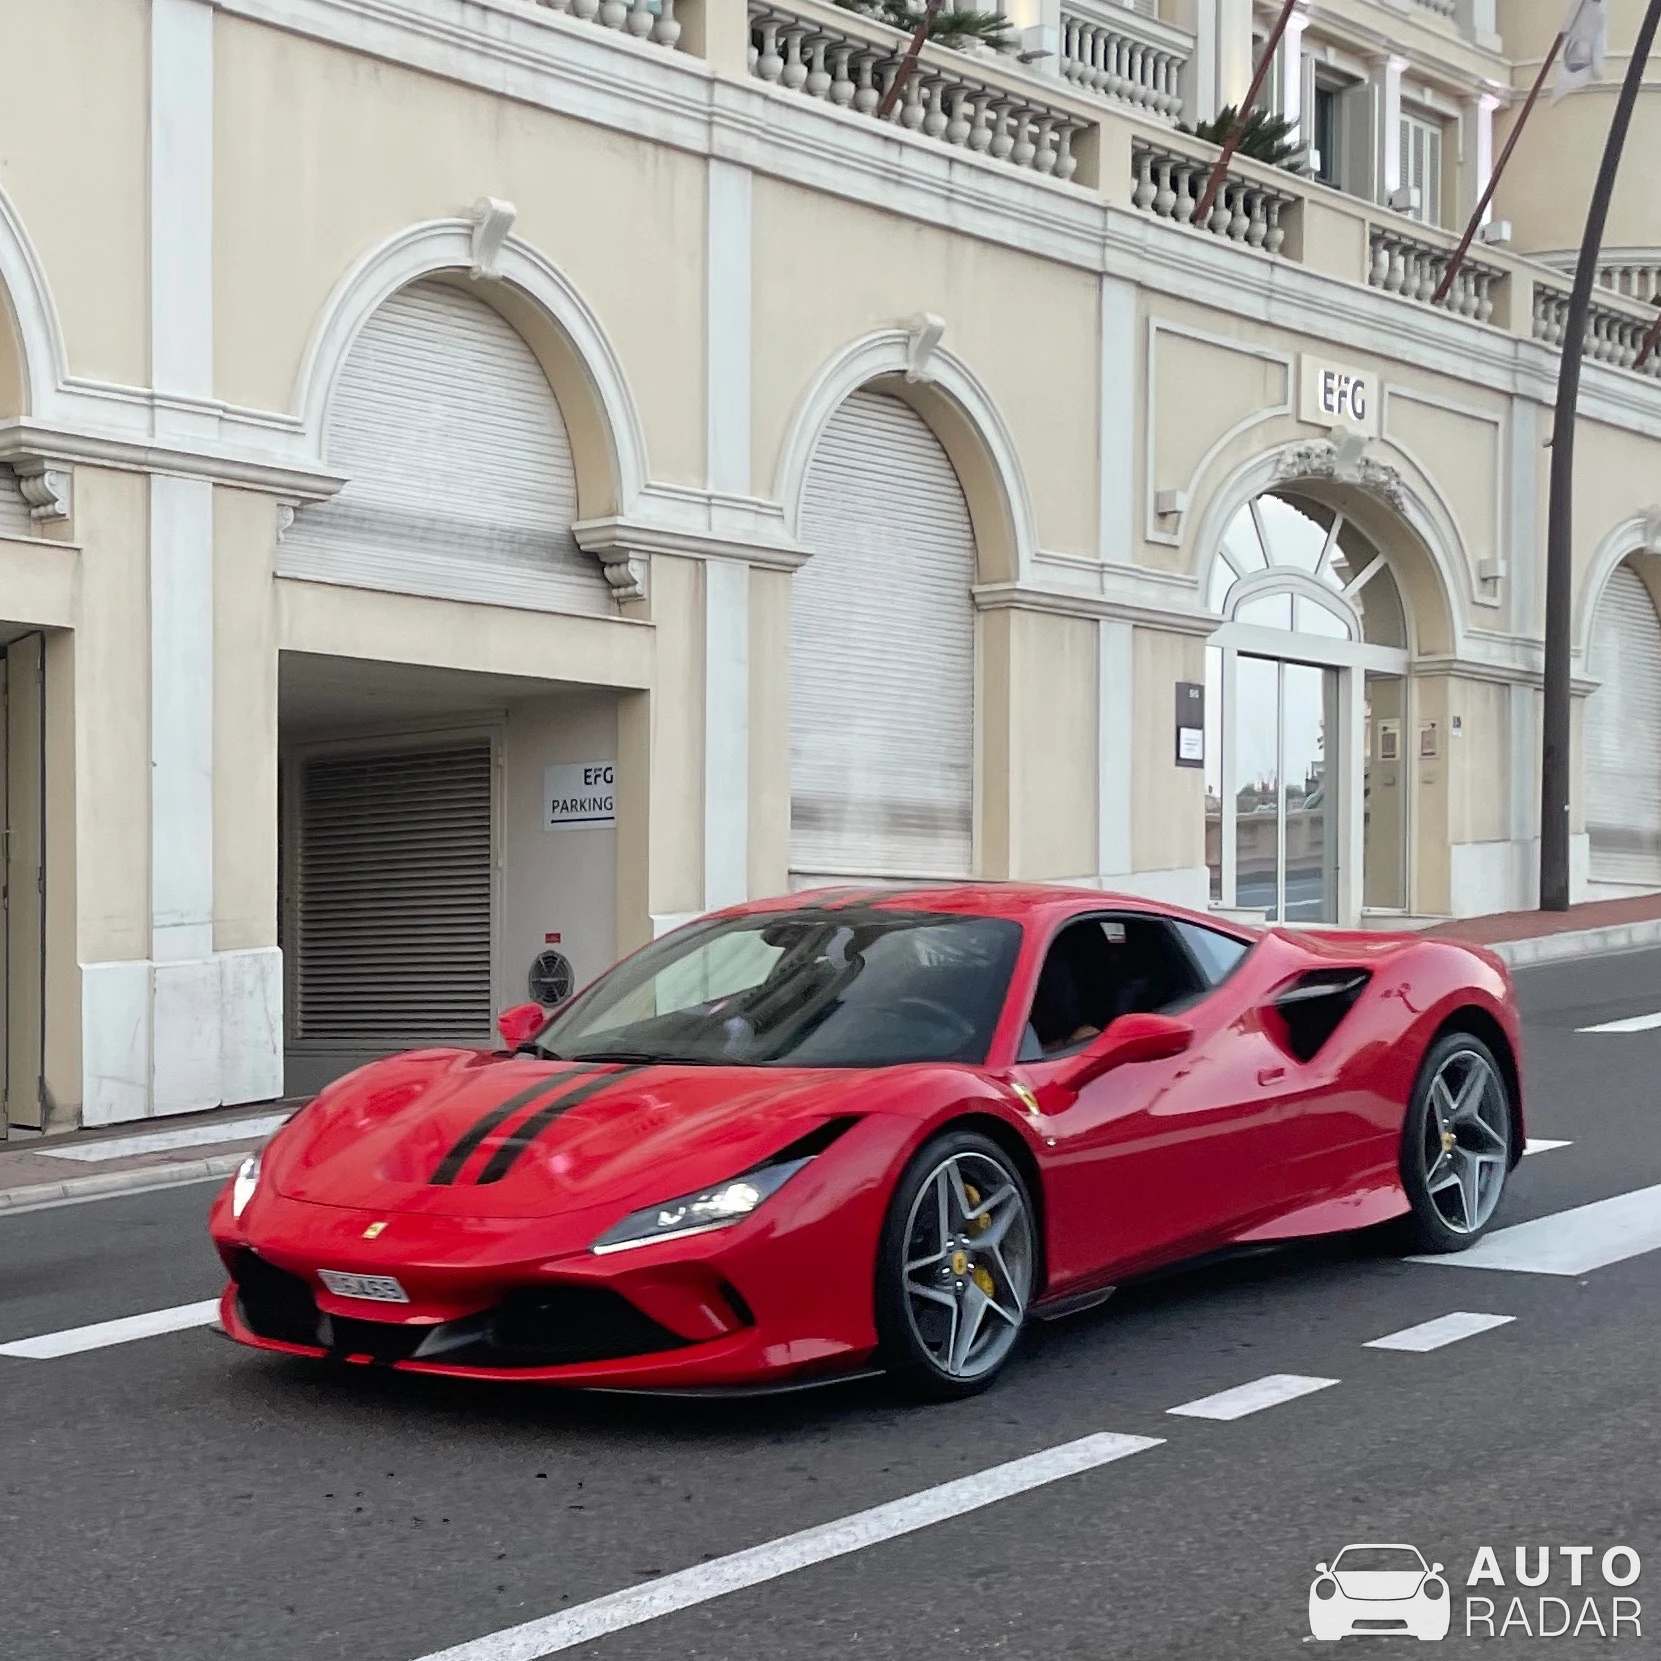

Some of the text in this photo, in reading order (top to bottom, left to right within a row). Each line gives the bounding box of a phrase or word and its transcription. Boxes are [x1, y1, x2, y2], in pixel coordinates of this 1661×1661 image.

[1321, 370, 1365, 420] EFG
[583, 766, 614, 786] EFG
[551, 795, 614, 814] PARKING
